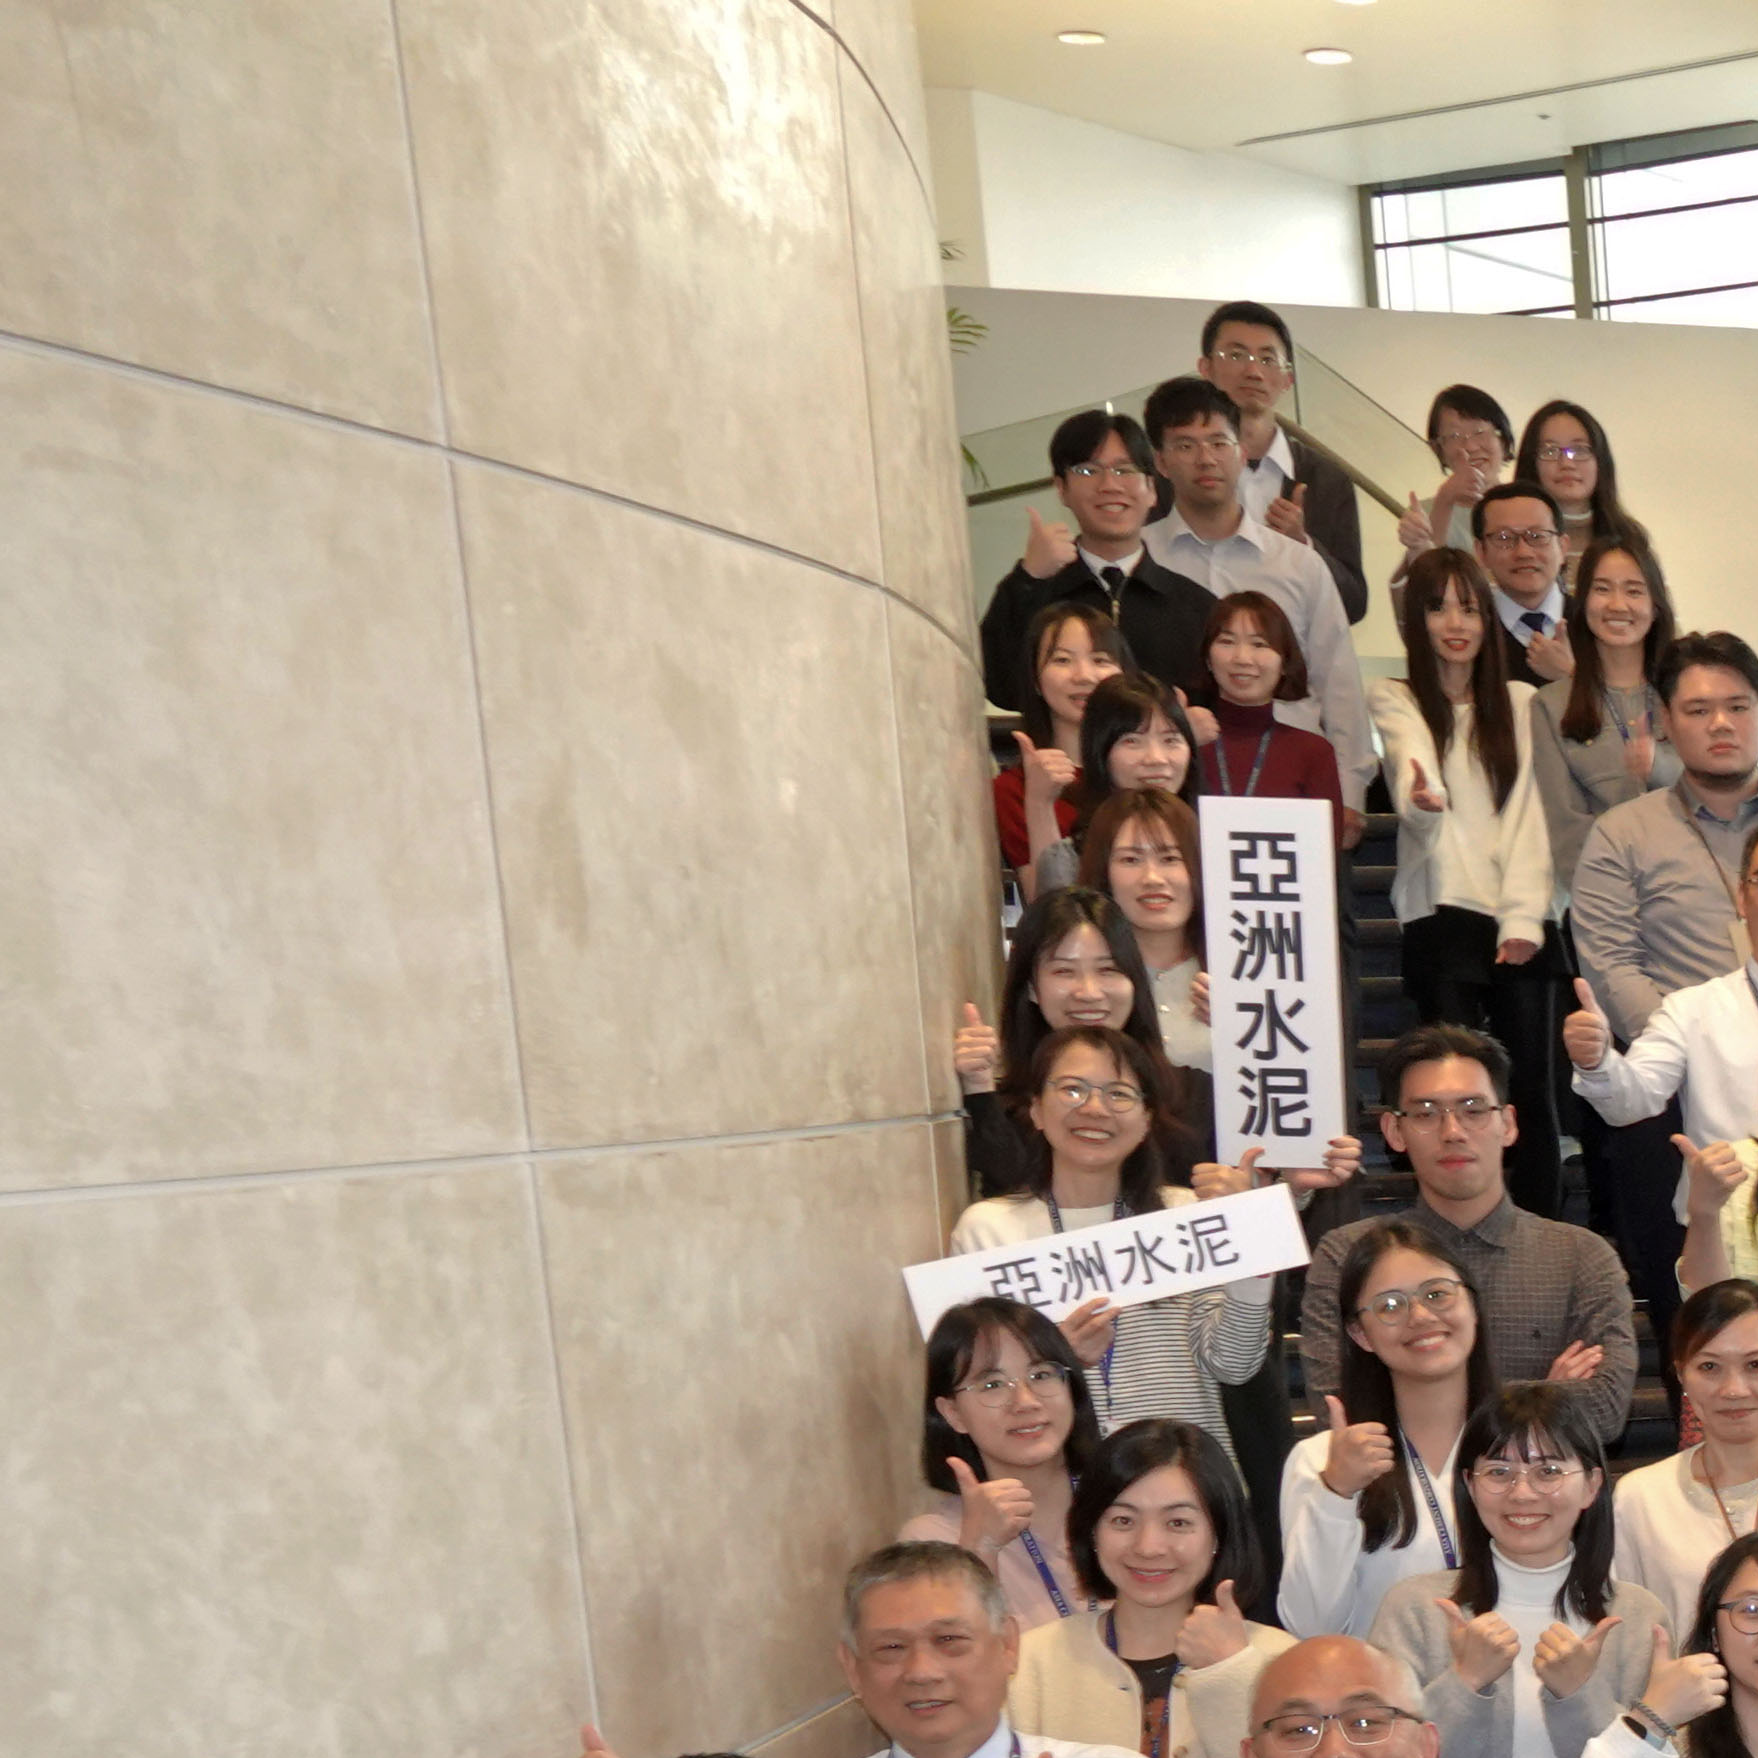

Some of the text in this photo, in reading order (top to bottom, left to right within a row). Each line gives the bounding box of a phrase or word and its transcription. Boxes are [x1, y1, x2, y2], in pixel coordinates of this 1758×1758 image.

[1228, 830, 1312, 1138] 亞洲水泥
[983, 1213, 1240, 1308] 亞洲水泥
